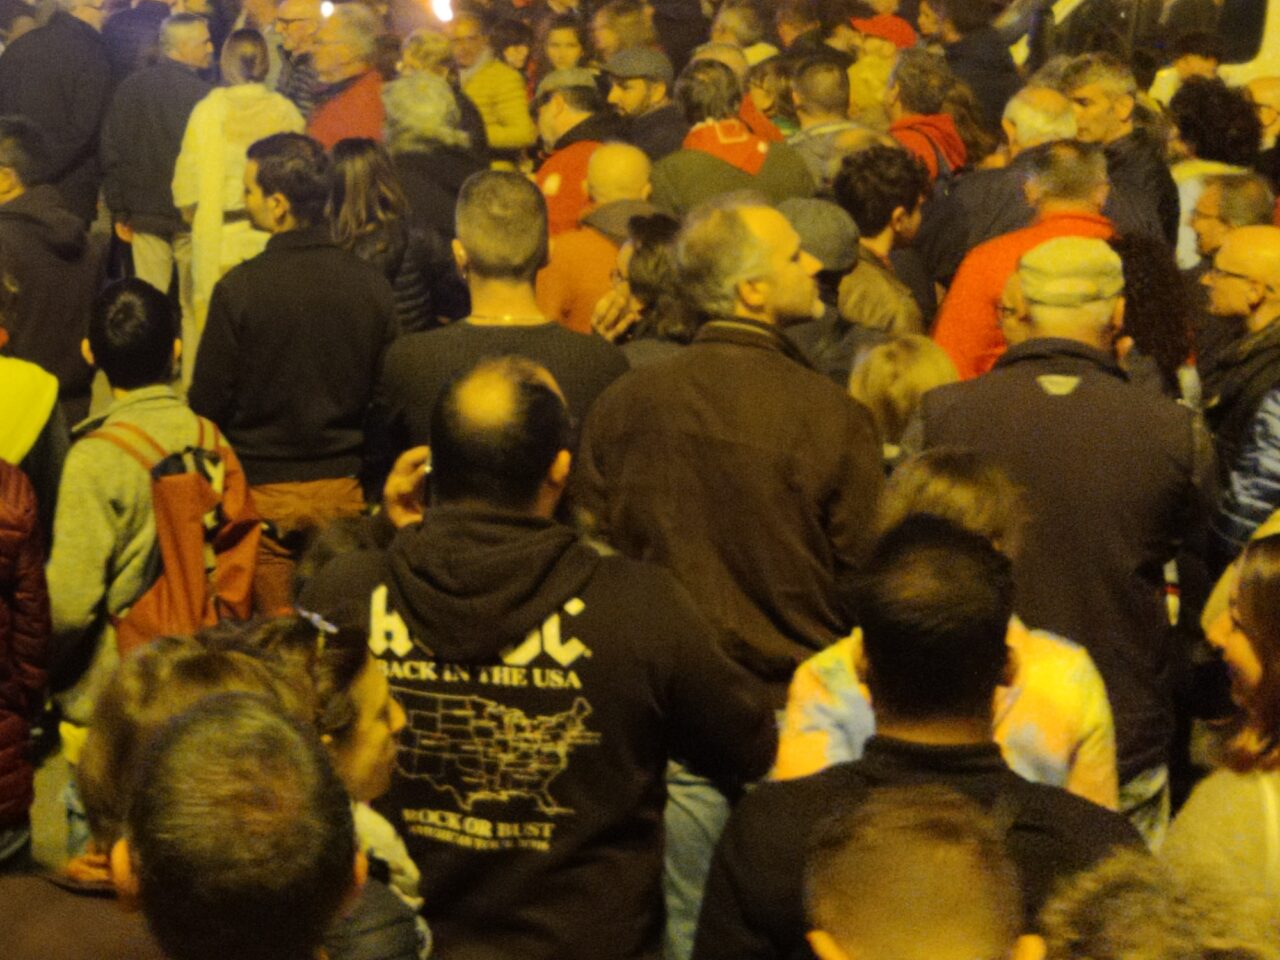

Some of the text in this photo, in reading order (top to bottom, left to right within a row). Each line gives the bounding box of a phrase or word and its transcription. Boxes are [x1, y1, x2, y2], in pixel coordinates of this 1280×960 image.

[532, 668, 582, 689] USA
[462, 814, 493, 839] OR
[497, 821, 555, 839] BUST
